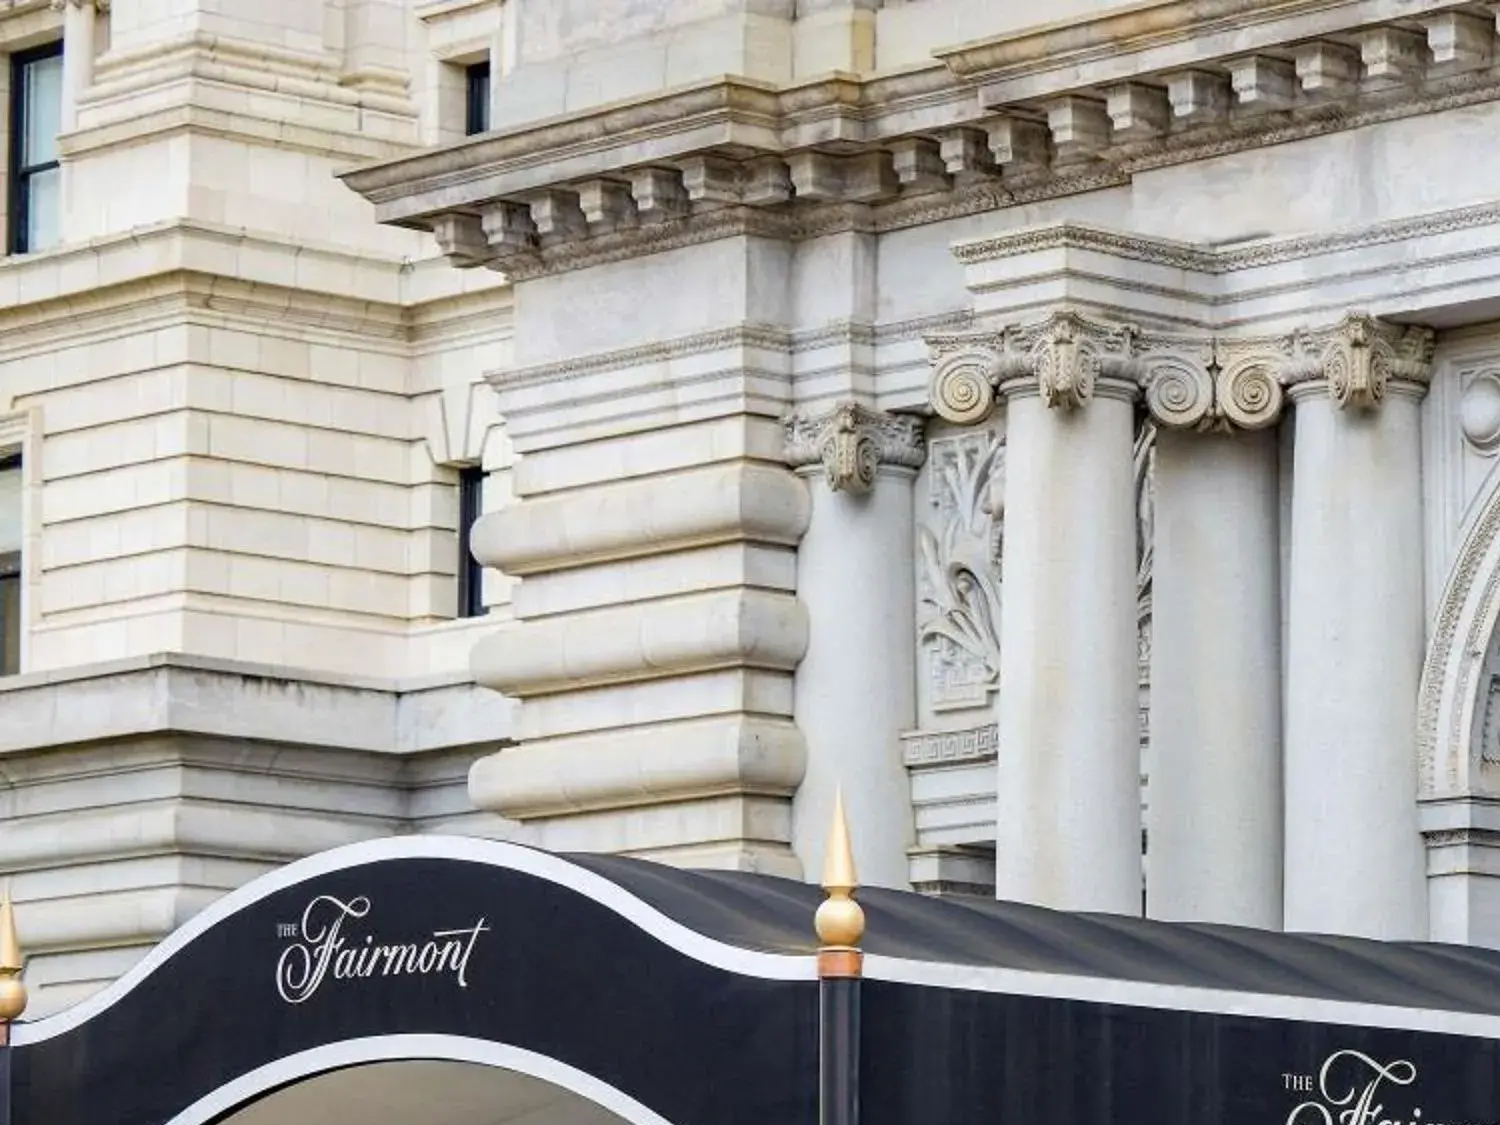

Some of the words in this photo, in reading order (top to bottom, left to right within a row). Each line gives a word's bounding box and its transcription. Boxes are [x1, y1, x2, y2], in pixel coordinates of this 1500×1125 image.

[277, 923, 298, 938] THE
[276, 895, 492, 1004] Fairmont
[1281, 1073, 1313, 1091] THE
